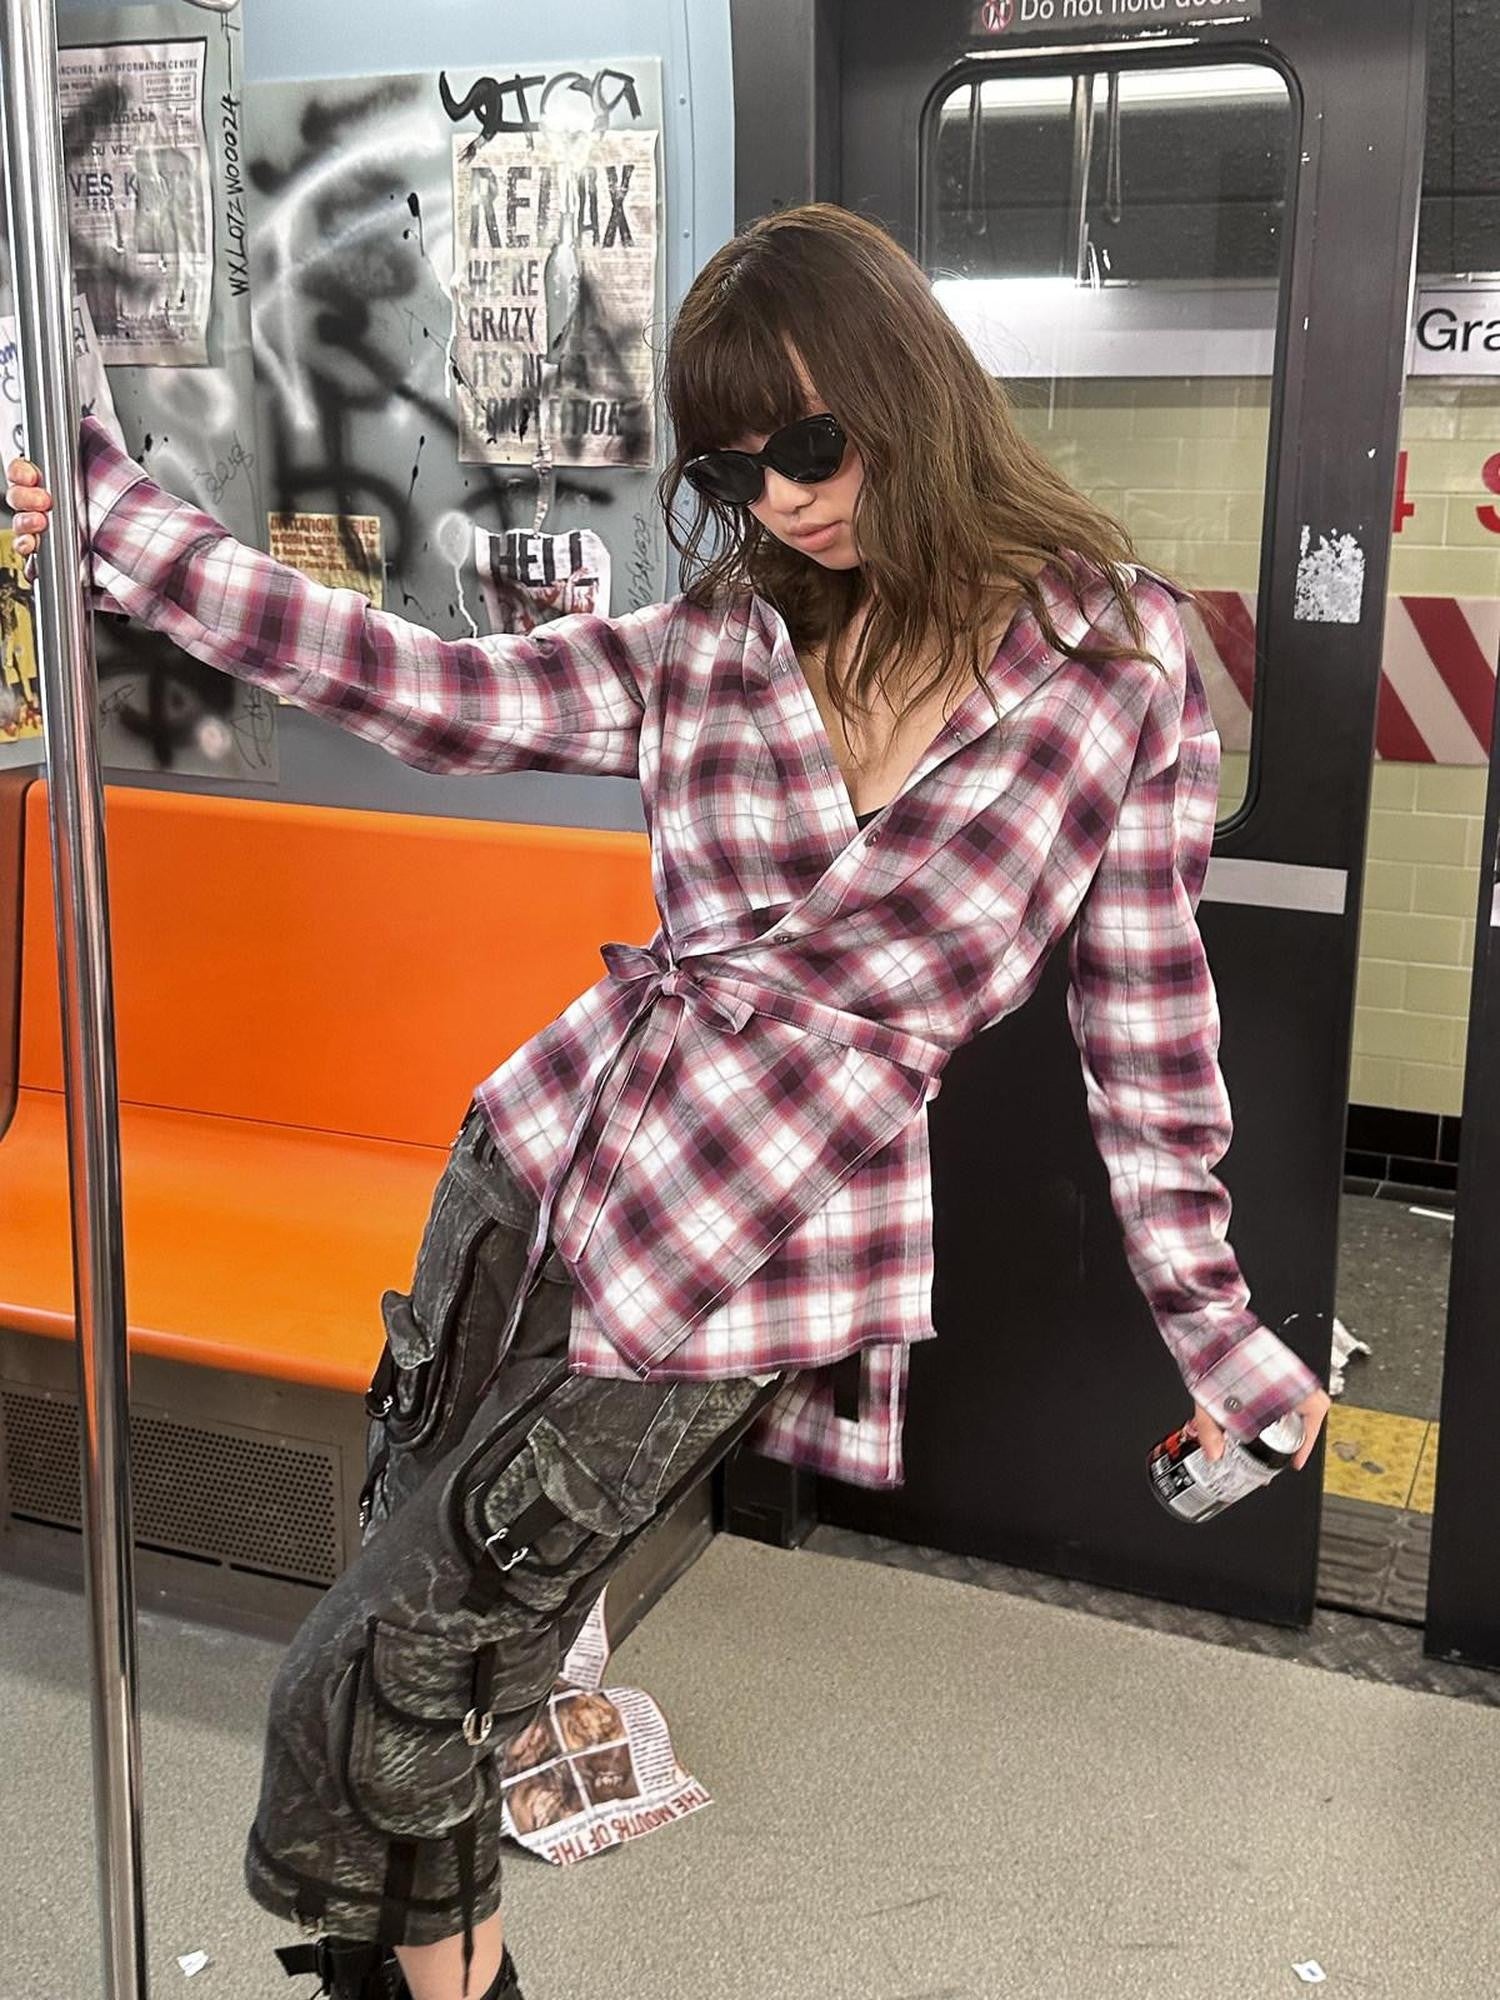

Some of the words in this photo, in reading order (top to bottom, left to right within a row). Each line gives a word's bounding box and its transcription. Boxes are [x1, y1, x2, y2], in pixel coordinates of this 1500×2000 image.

[1021, 0, 1054, 20] Do
[468, 307, 536, 342] CRAZY
[489, 532, 599, 588] HELL
[672, 1786, 711, 1812] THE
[590, 1823, 613, 1850] OF
